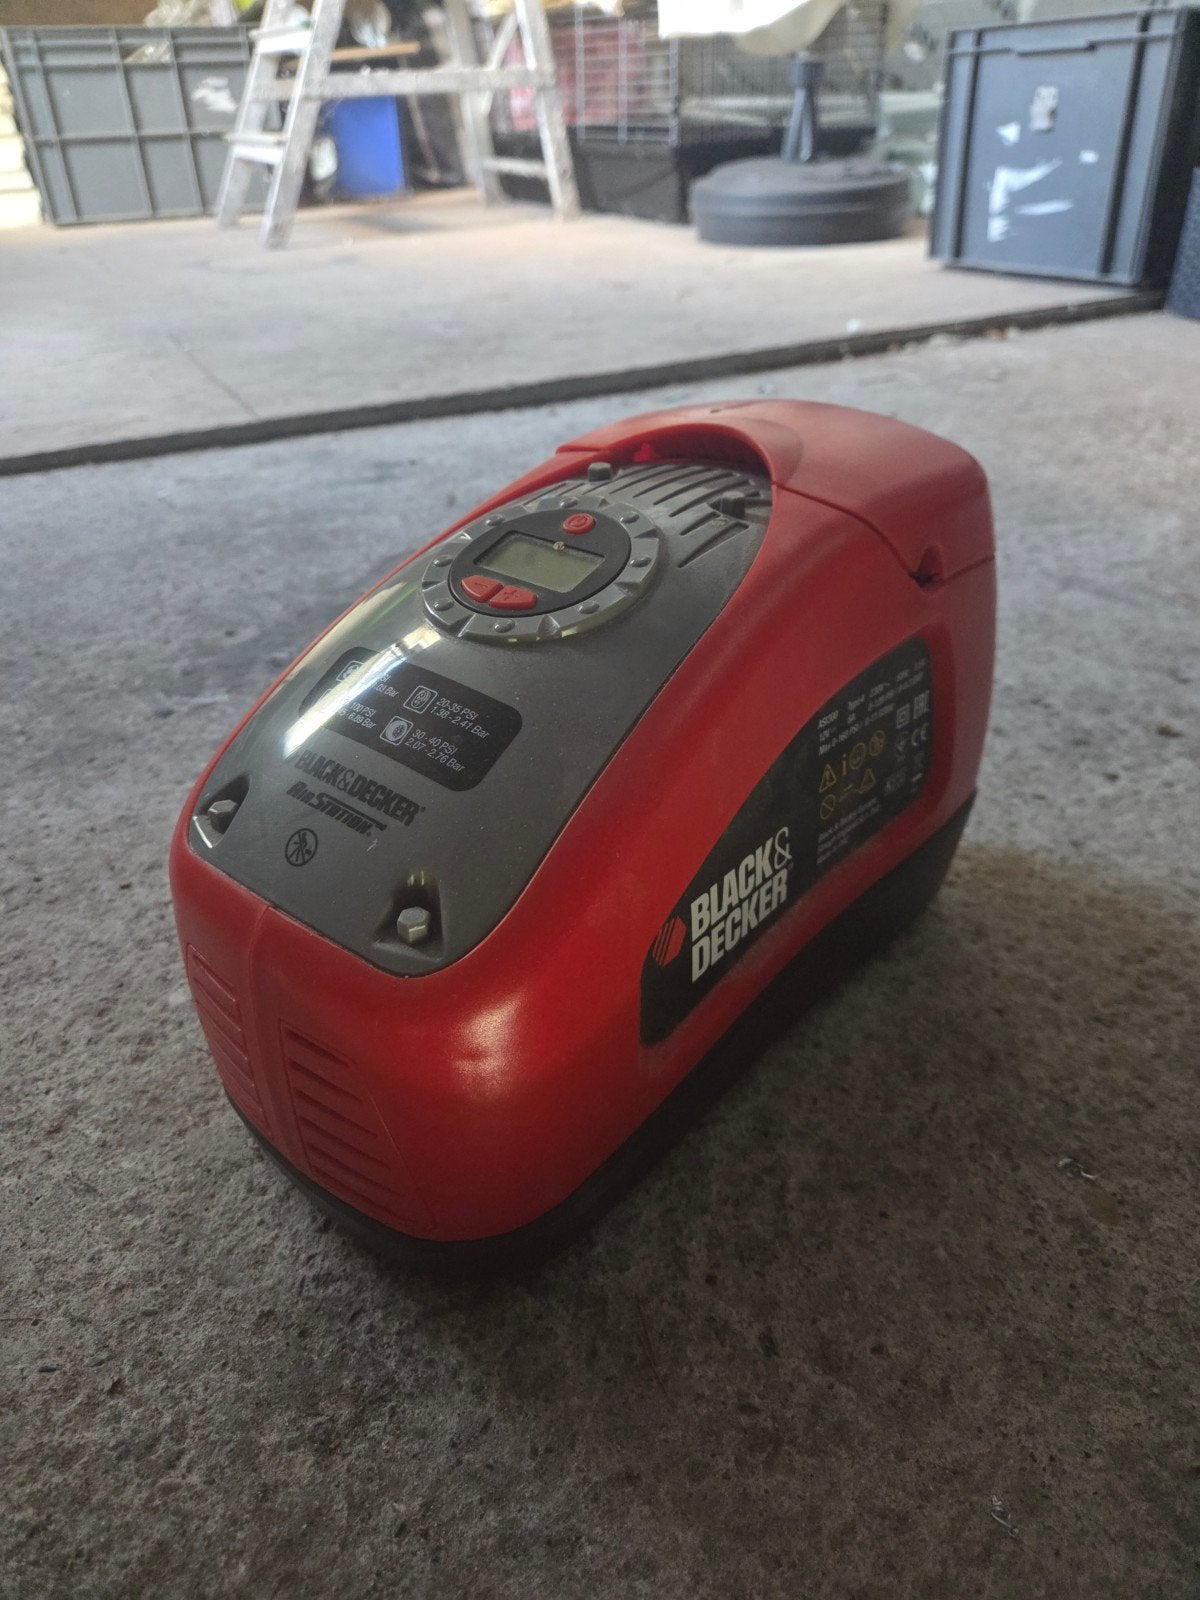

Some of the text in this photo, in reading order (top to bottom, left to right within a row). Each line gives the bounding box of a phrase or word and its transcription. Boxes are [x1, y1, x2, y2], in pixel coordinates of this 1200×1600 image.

[360, 706, 377, 717] PSI
[361, 717, 377, 728] Bar
[430, 705, 450, 719] 1.38
[451, 716, 473, 730] 2.41
[470, 724, 490, 739] Bar
[460, 707, 479, 720] PSI
[404, 737, 426, 750] 2.07
[427, 748, 449, 764] 2.76
[446, 757, 466, 772] Bar
[412, 729, 426, 740] 30
[428, 736, 442, 748] 40
[439, 741, 458, 755] PSI
[691, 868, 788, 983] DECKER
